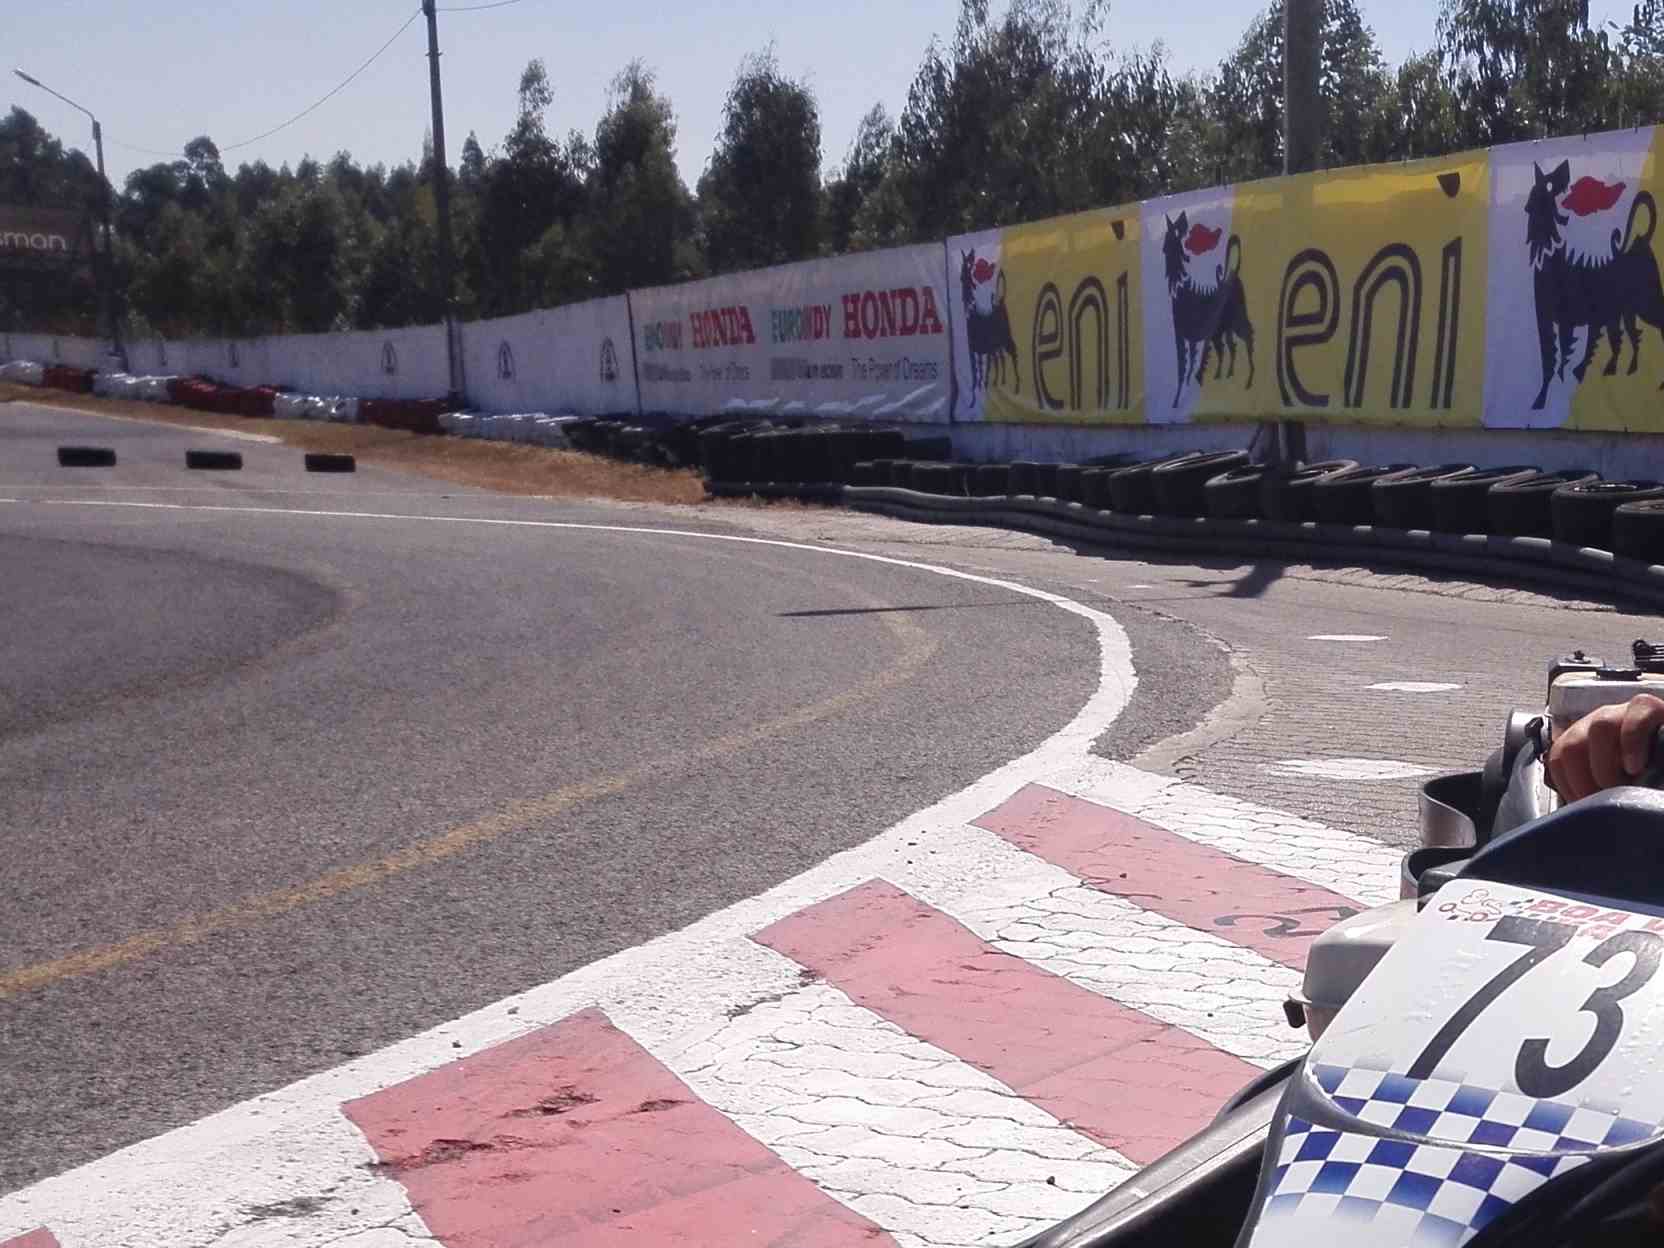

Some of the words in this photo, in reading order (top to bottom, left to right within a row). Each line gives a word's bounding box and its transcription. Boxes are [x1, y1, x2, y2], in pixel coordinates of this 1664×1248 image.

[689, 305, 756, 349] HONDA
[842, 286, 944, 339] HONDA
[1031, 220, 1130, 410] eni
[1277, 172, 1463, 409] eni
[1526, 899, 1632, 925] BOA
[1405, 915, 1664, 1098] 73
